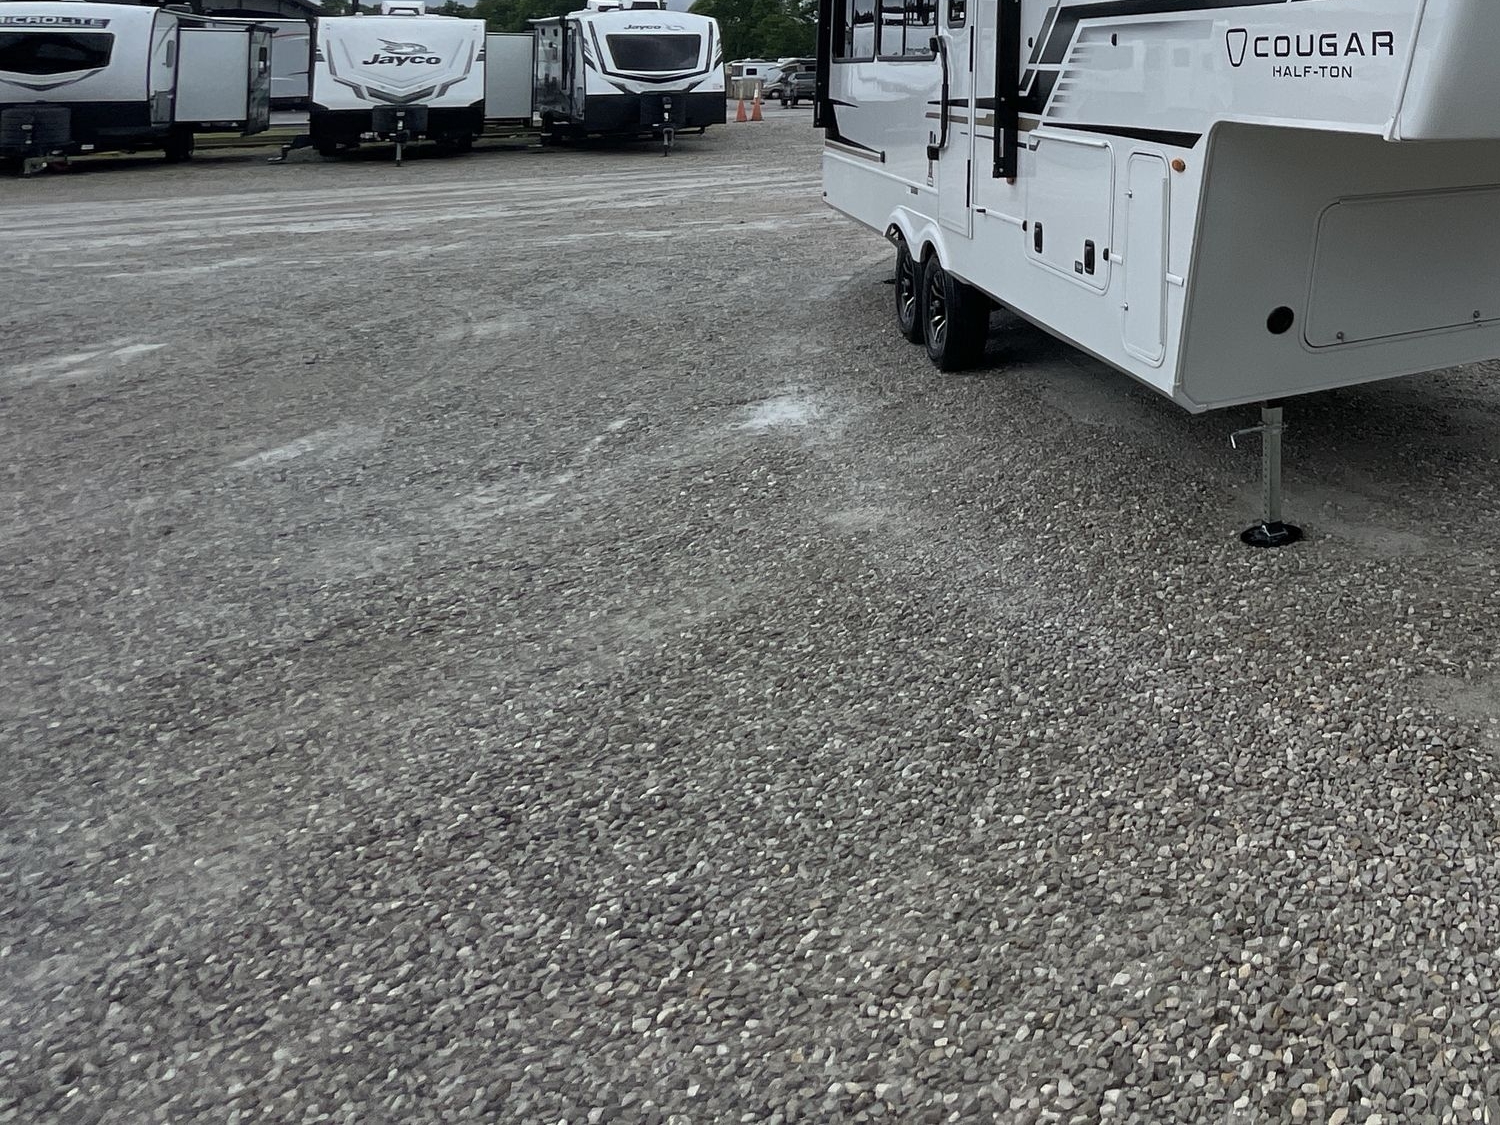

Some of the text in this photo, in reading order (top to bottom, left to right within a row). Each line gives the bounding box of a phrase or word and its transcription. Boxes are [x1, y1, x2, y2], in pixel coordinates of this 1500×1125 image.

[1254, 31, 1394, 57] COUGAR
[362, 54, 441, 66] Jayco
[1272, 66, 1353, 78] HALF-TON
